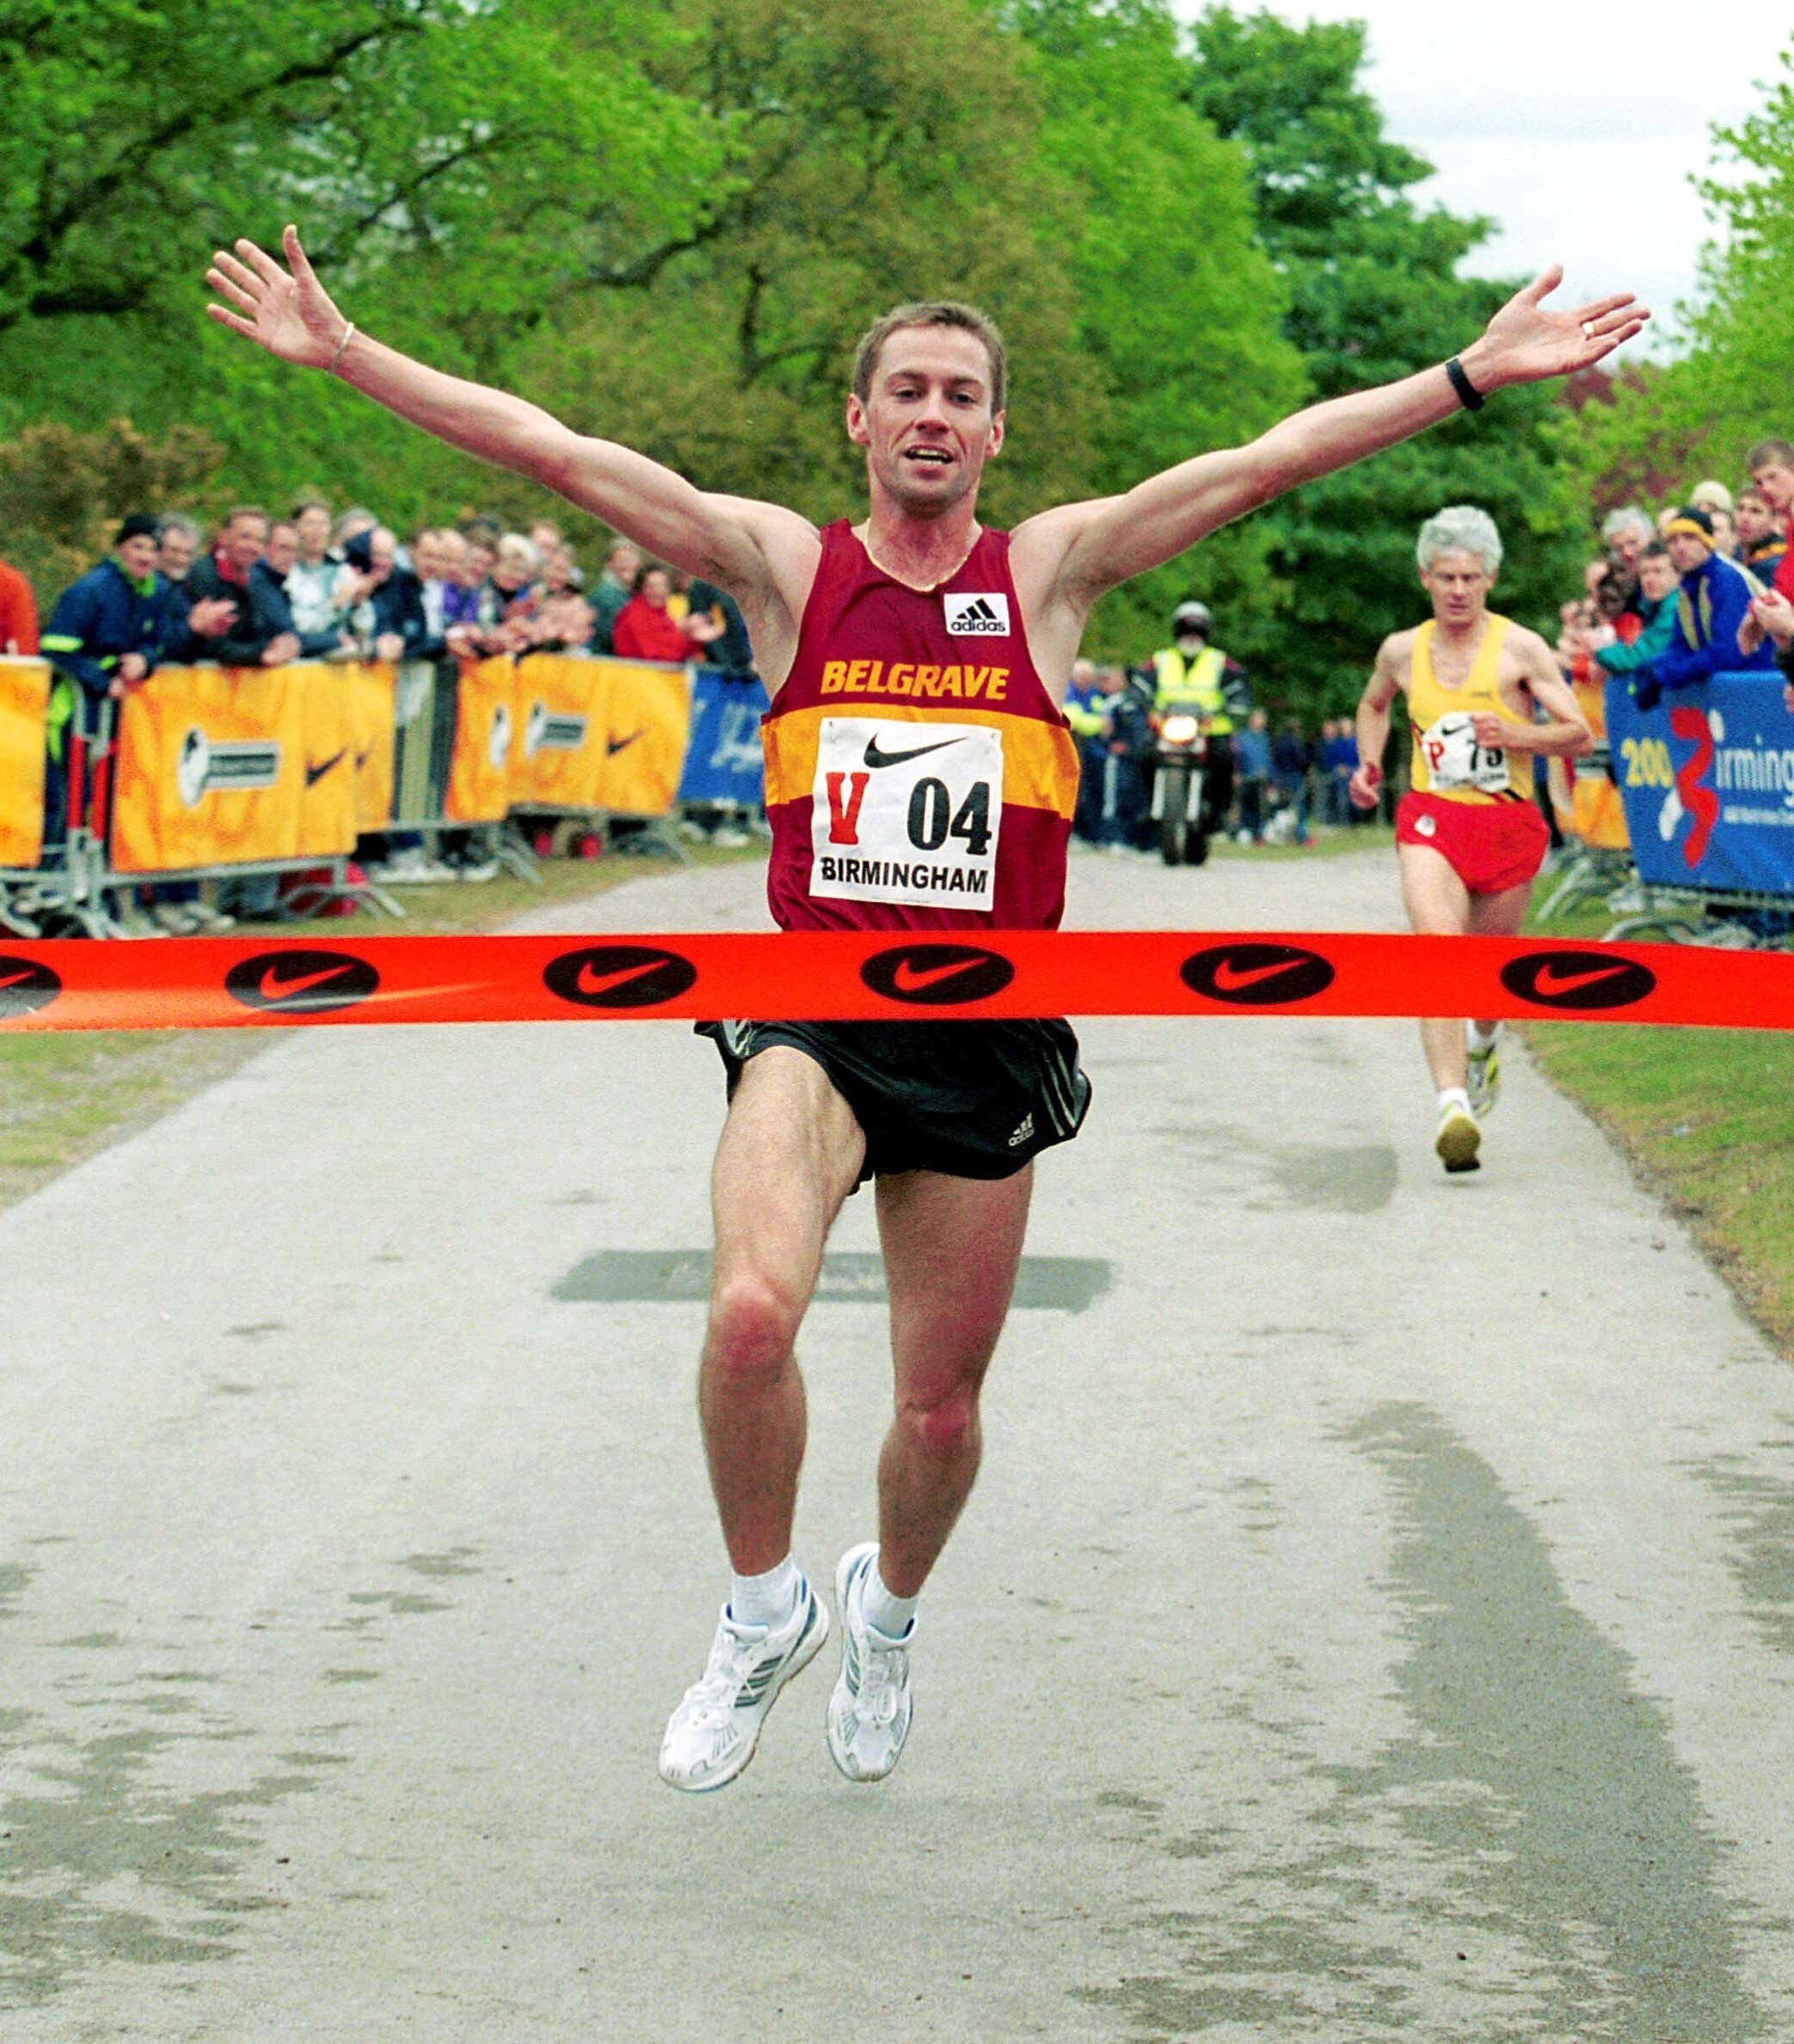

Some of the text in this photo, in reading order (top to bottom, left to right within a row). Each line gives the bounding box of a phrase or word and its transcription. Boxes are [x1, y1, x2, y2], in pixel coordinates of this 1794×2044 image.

[950, 618, 1006, 633] adidas
[821, 659, 1010, 701] BELGRAVE
[1428, 742, 1445, 771] P
[826, 772, 992, 856] V 04
[821, 857, 988, 894] BIRMINGHAM
